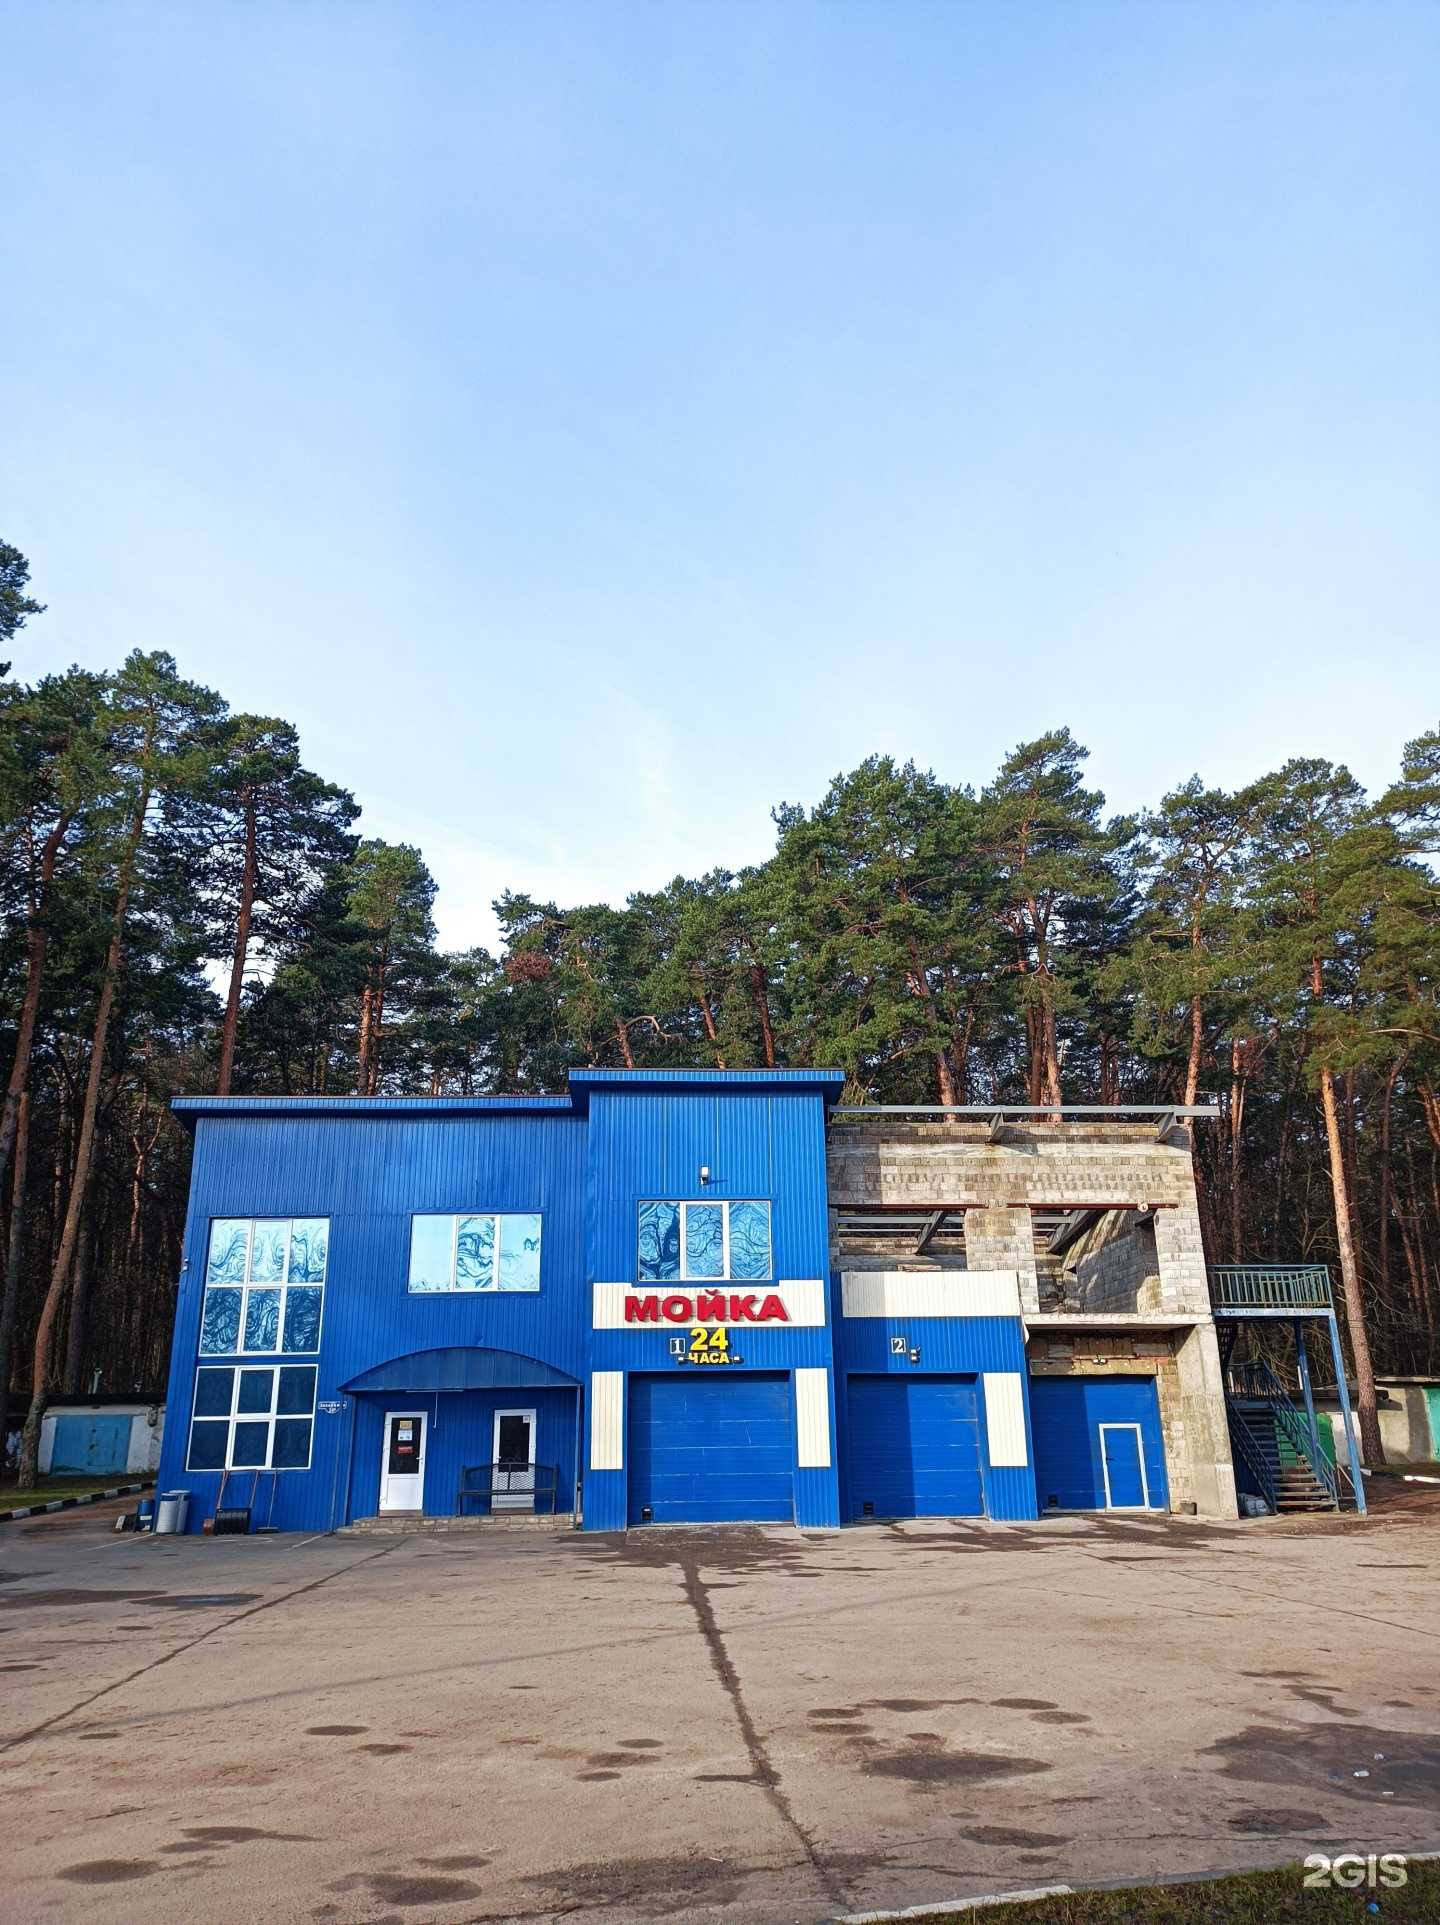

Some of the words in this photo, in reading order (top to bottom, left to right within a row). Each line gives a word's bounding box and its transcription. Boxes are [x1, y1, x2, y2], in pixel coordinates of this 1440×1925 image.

[624, 1289, 788, 1322] МОЙКА
[673, 1339, 682, 1354] 1
[690, 1328, 728, 1351] 24
[893, 1338, 904, 1353] 2
[688, 1353, 730, 1364] ЧАСА
